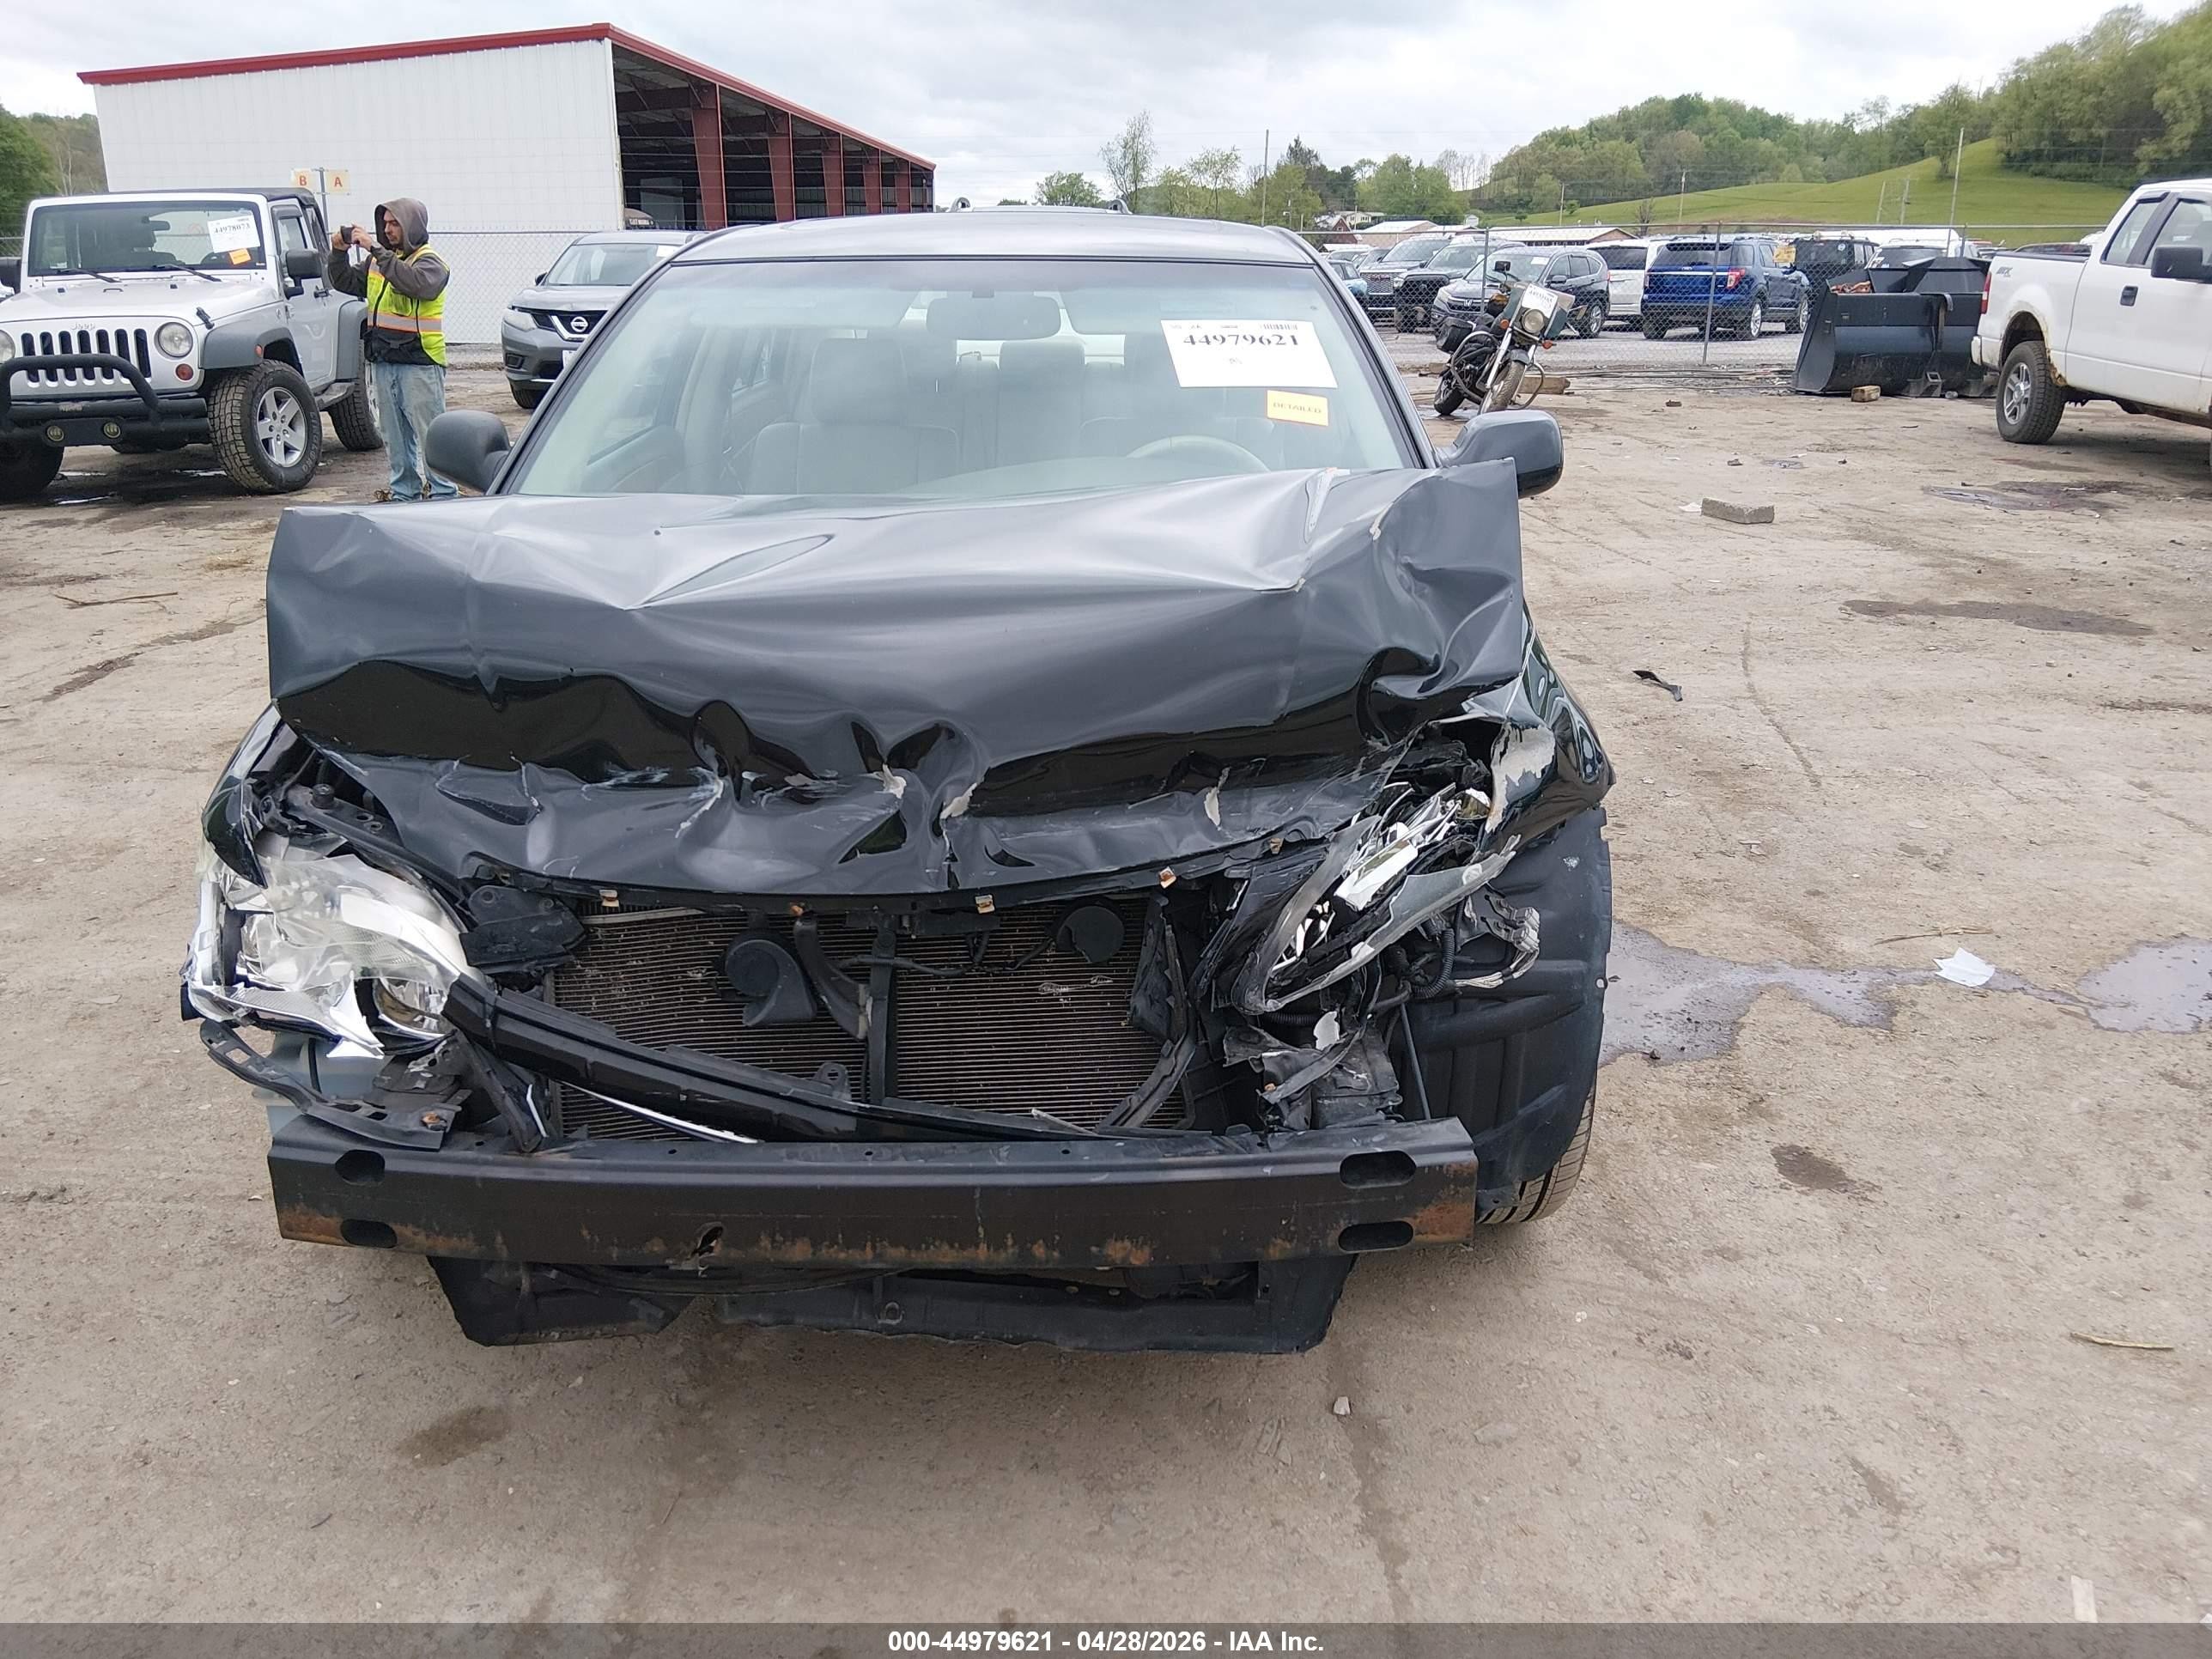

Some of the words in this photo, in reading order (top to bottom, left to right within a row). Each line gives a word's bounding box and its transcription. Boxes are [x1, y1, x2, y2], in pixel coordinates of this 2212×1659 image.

[299, 175, 307, 186] B
[333, 176, 343, 187] A
[1183, 334, 1298, 345] 44979621
